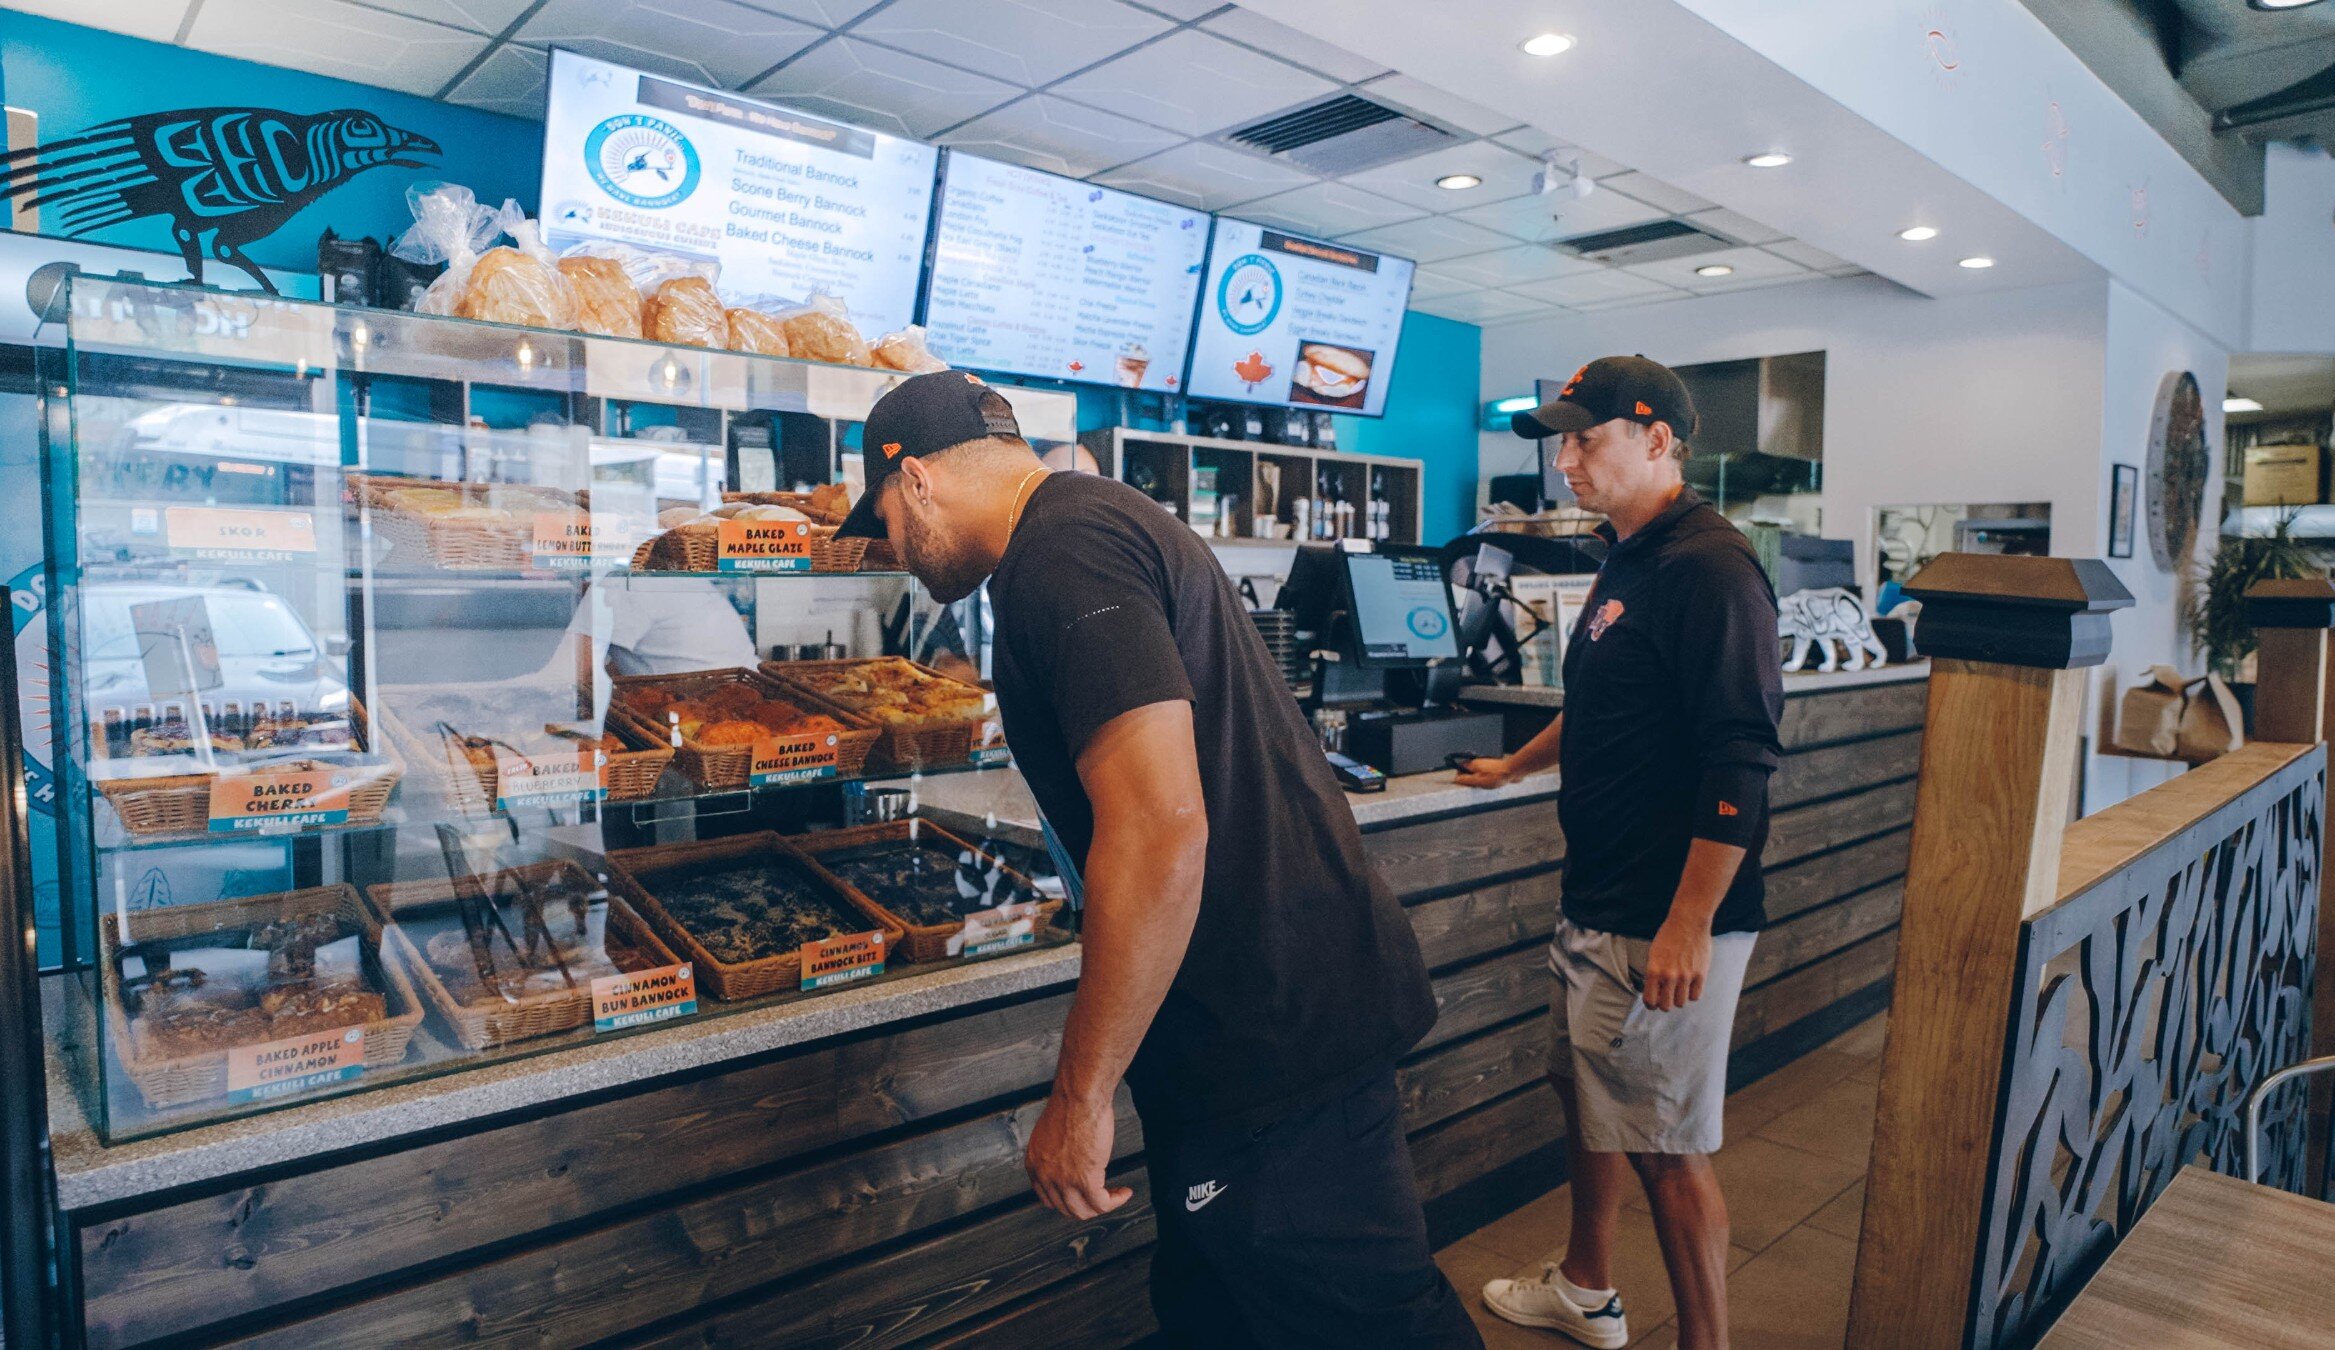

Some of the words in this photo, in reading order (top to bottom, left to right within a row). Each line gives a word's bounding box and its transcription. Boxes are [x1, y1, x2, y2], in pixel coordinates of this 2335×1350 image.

[735, 147, 803, 176] Traditional
[805, 165, 859, 190] Bannock
[730, 177, 773, 199] Scone
[777, 186, 811, 210] Berry
[814, 194, 867, 218] Bannock
[728, 200, 786, 224] Gourmet
[789, 212, 843, 235] Bannock
[725, 222, 768, 243] Baked
[771, 231, 820, 253] Cheese
[823, 240, 875, 263] Bannock
[217, 526, 266, 538] SKOR
[746, 528, 785, 540] BAKED
[256, 550, 293, 562] CAFE
[727, 542, 766, 554] MAPLE
[768, 542, 803, 554] GLAZE
[734, 559, 771, 570] KEKULI
[772, 559, 796, 569] CAFE
[779, 741, 816, 755] BAKED
[531, 762, 580, 777] BAKED
[755, 755, 791, 771] CHEESE
[792, 752, 836, 767] BANNOCK
[512, 776, 581, 792] BLUEBERRY
[765, 770, 800, 784] KEKULI
[800, 768, 823, 780] CAFE
[253, 782, 313, 798] BAKED
[516, 795, 563, 807] KEKULI
[562, 791, 591, 803] CAFE
[233, 816, 289, 830] KEKULI
[290, 813, 326, 827] CAFE
[819, 940, 869, 959] CINNAMON
[810, 955, 855, 974] BANNOCK
[612, 974, 677, 996] CINNAMON
[815, 970, 850, 986] KEKULI
[849, 966, 873, 979] CAFE
[601, 998, 628, 1014] BUN
[631, 986, 689, 1008] BANNOCK
[612, 1010, 654, 1027] KEKULI
[655, 1005, 682, 1020] CAFE
[255, 1046, 298, 1066] BAKED
[301, 1038, 340, 1057] APPLE
[258, 1054, 337, 1080] CINNAMON
[251, 1077, 306, 1099] KEKULI
[307, 1069, 342, 1086] CAFE
[1188, 1179, 1216, 1201] NIKE
